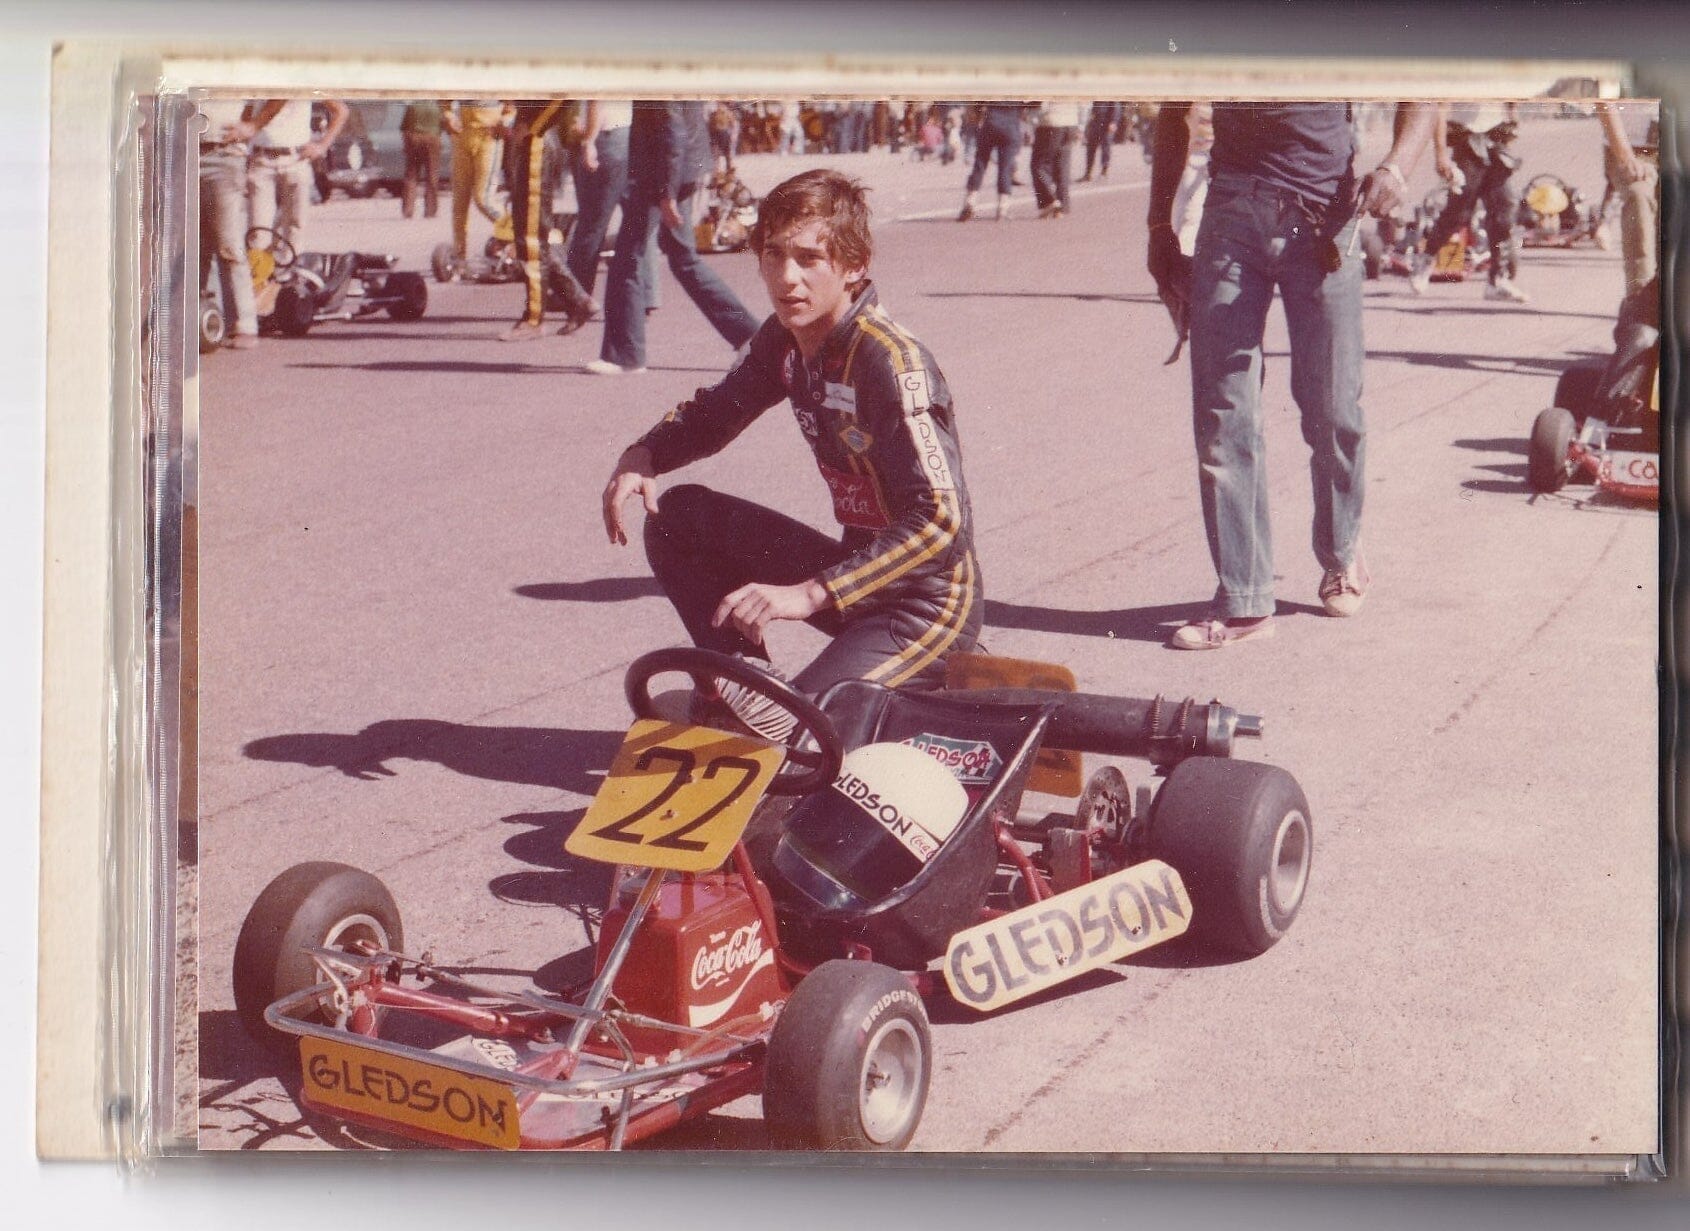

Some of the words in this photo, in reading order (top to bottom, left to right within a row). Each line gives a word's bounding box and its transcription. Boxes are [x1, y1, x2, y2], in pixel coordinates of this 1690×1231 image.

[587, 746, 762, 851] 22
[835, 773, 914, 837] LEDSON
[951, 867, 1186, 1004] GLEDSON
[309, 1054, 508, 1133] GLEDSON
